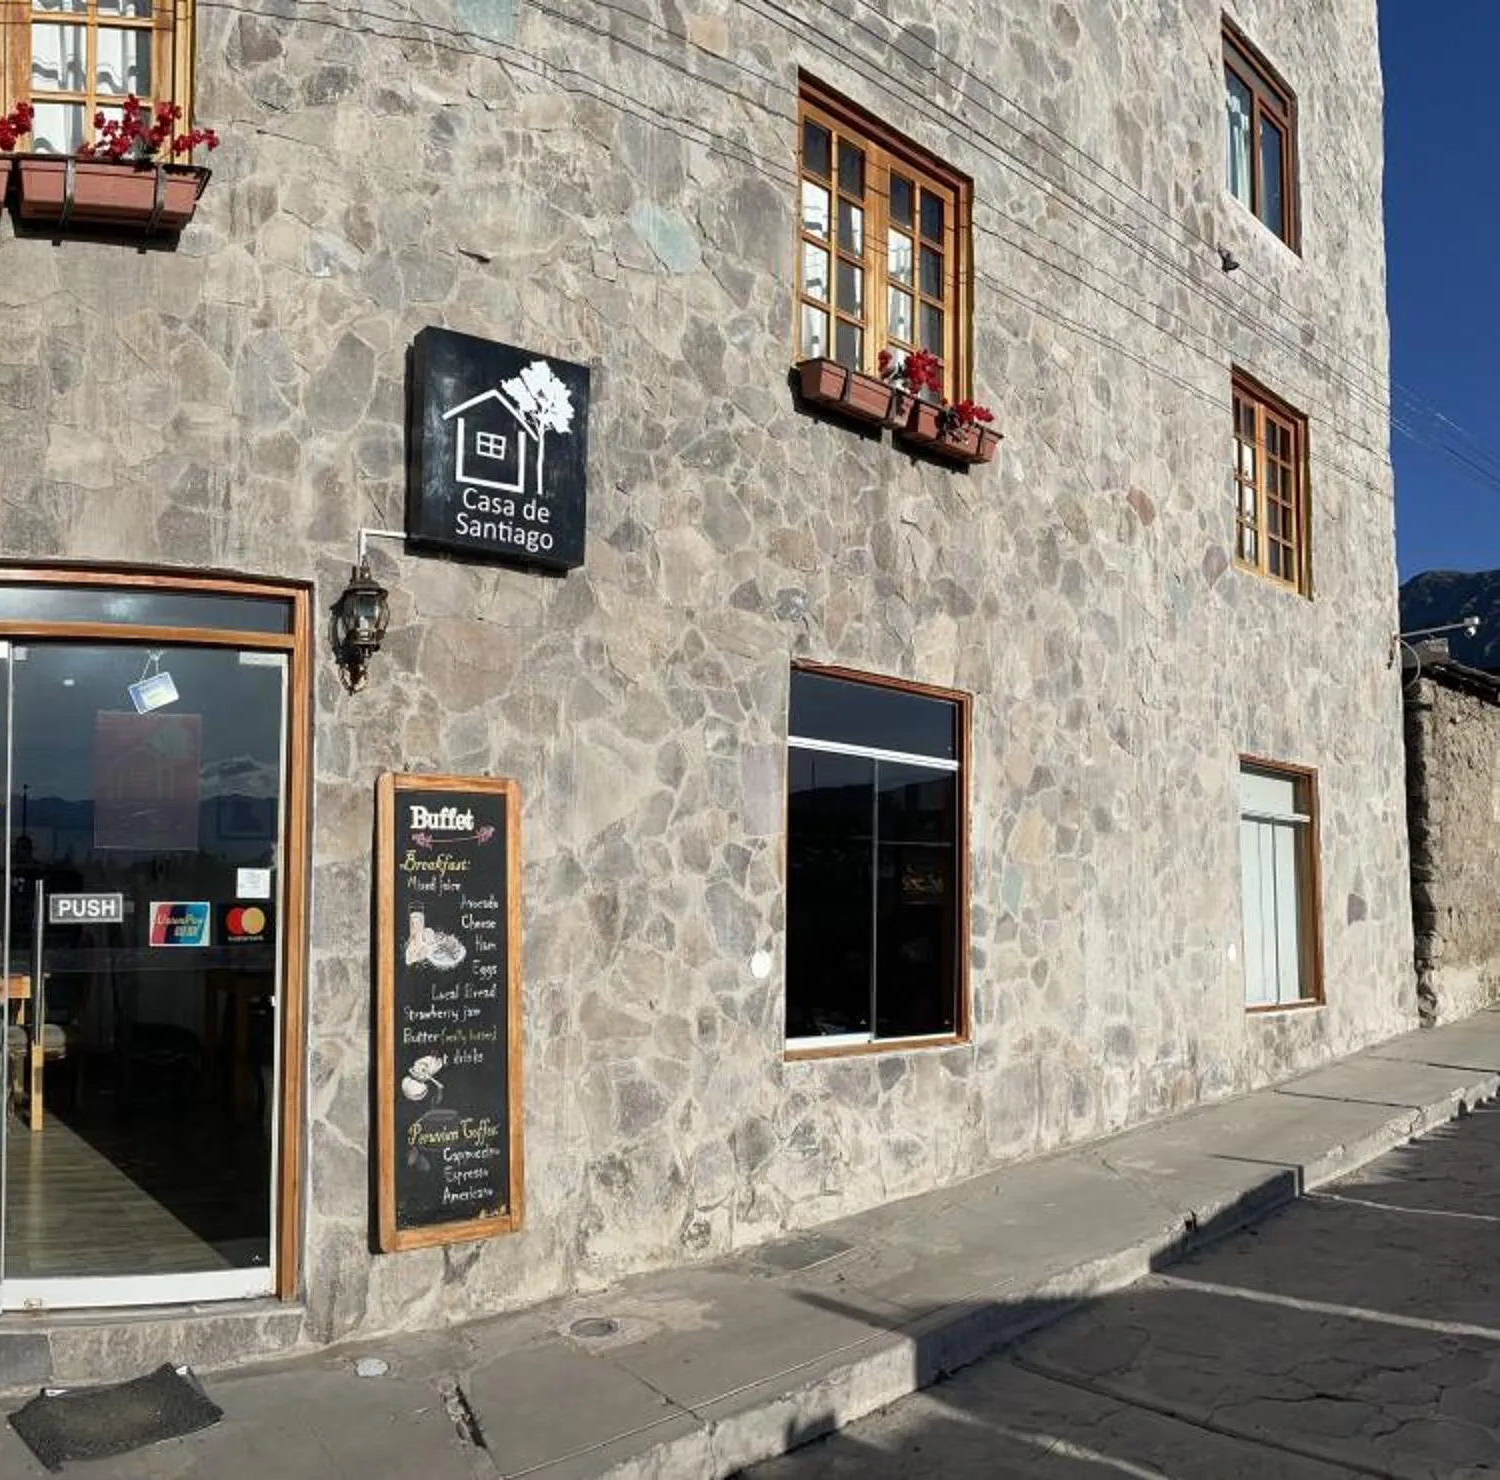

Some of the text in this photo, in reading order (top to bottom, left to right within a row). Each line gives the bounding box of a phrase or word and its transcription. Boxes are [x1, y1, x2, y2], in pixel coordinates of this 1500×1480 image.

[462, 487, 550, 523] Casa de
[455, 512, 554, 553] Santiago
[409, 805, 475, 831] Buffet
[58, 900, 116, 917] PUSH
[461, 913, 497, 931] Cheese
[472, 959, 498, 981] Eggs
